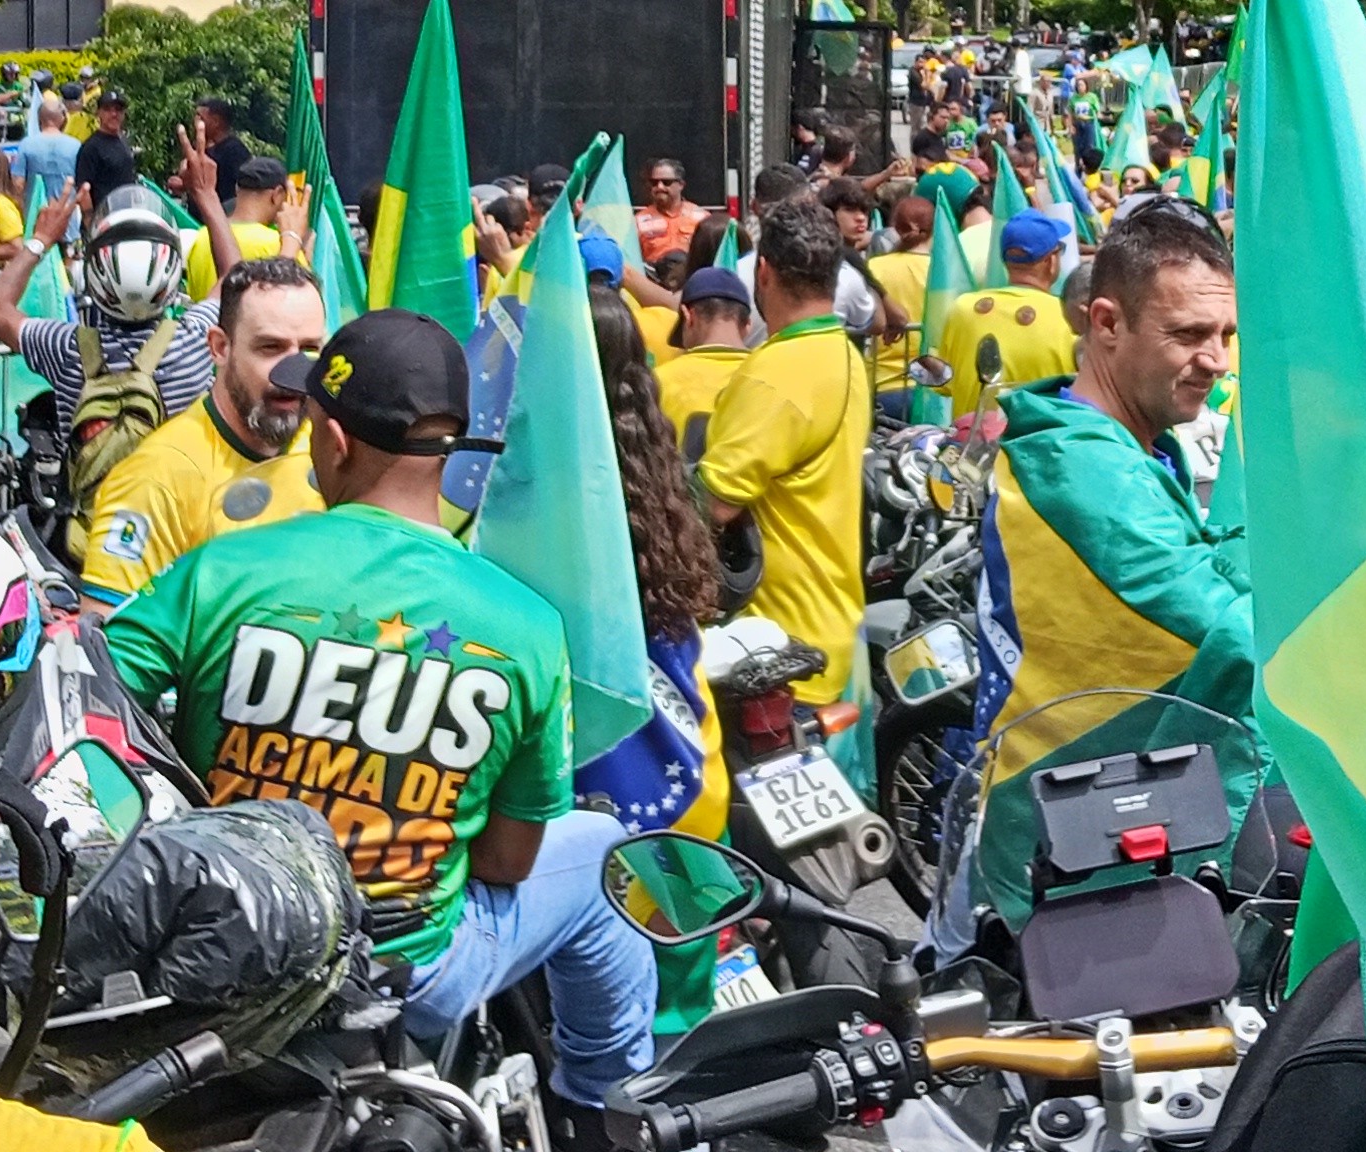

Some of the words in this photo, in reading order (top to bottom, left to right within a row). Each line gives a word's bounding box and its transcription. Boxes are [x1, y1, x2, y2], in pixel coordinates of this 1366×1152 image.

[221, 624, 510, 769] DEUS
[216, 725, 387, 803] ACIMA
[396, 760, 467, 817] DE
[766, 768, 826, 805] GZL
[775, 789, 852, 838] 1E61
